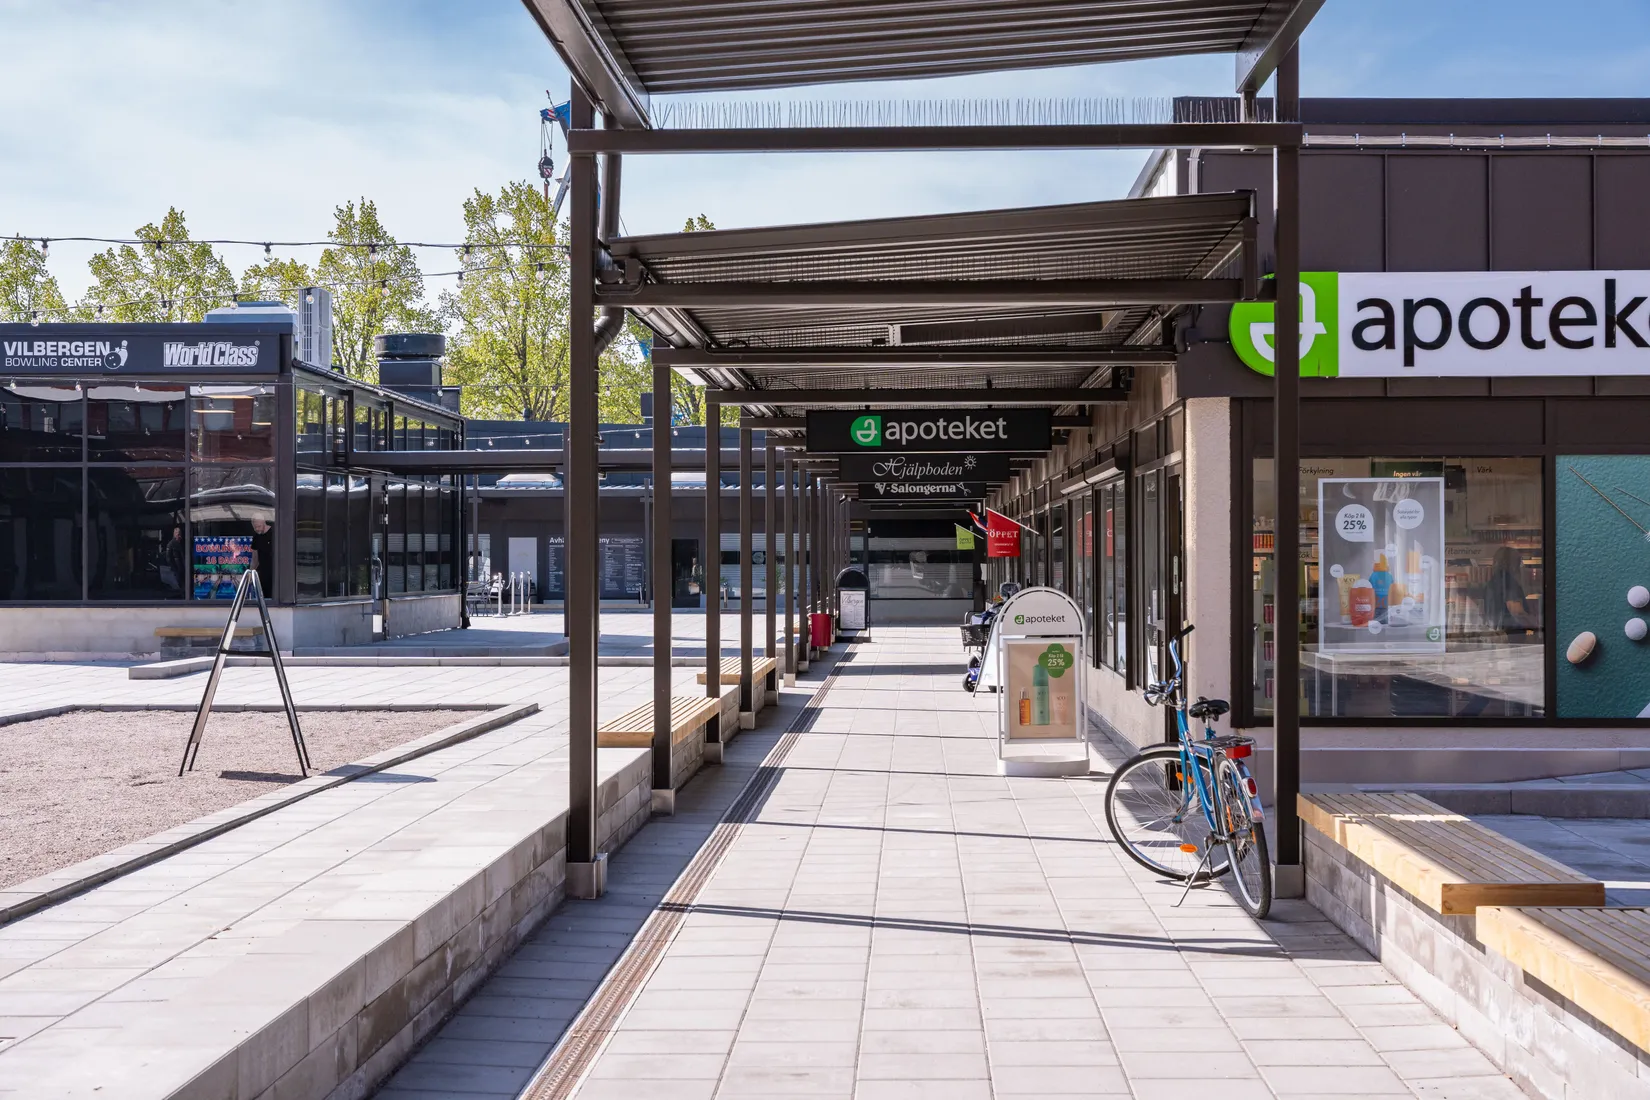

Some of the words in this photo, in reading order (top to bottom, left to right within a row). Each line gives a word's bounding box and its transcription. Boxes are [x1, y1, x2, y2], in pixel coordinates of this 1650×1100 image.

[1351, 278, 1650, 368] apotek
[3, 341, 111, 356] VILBERGEN
[5, 357, 57, 367] BOWLING
[61, 357, 102, 367] CENTER
[885, 416, 1008, 445] apoteket
[872, 456, 963, 479] Hjälpboden
[1343, 520, 1367, 530] 25%
[989, 529, 1019, 538] ÖPPET
[1025, 614, 1066, 624] apoteket
[1047, 658, 1065, 667] 25%
